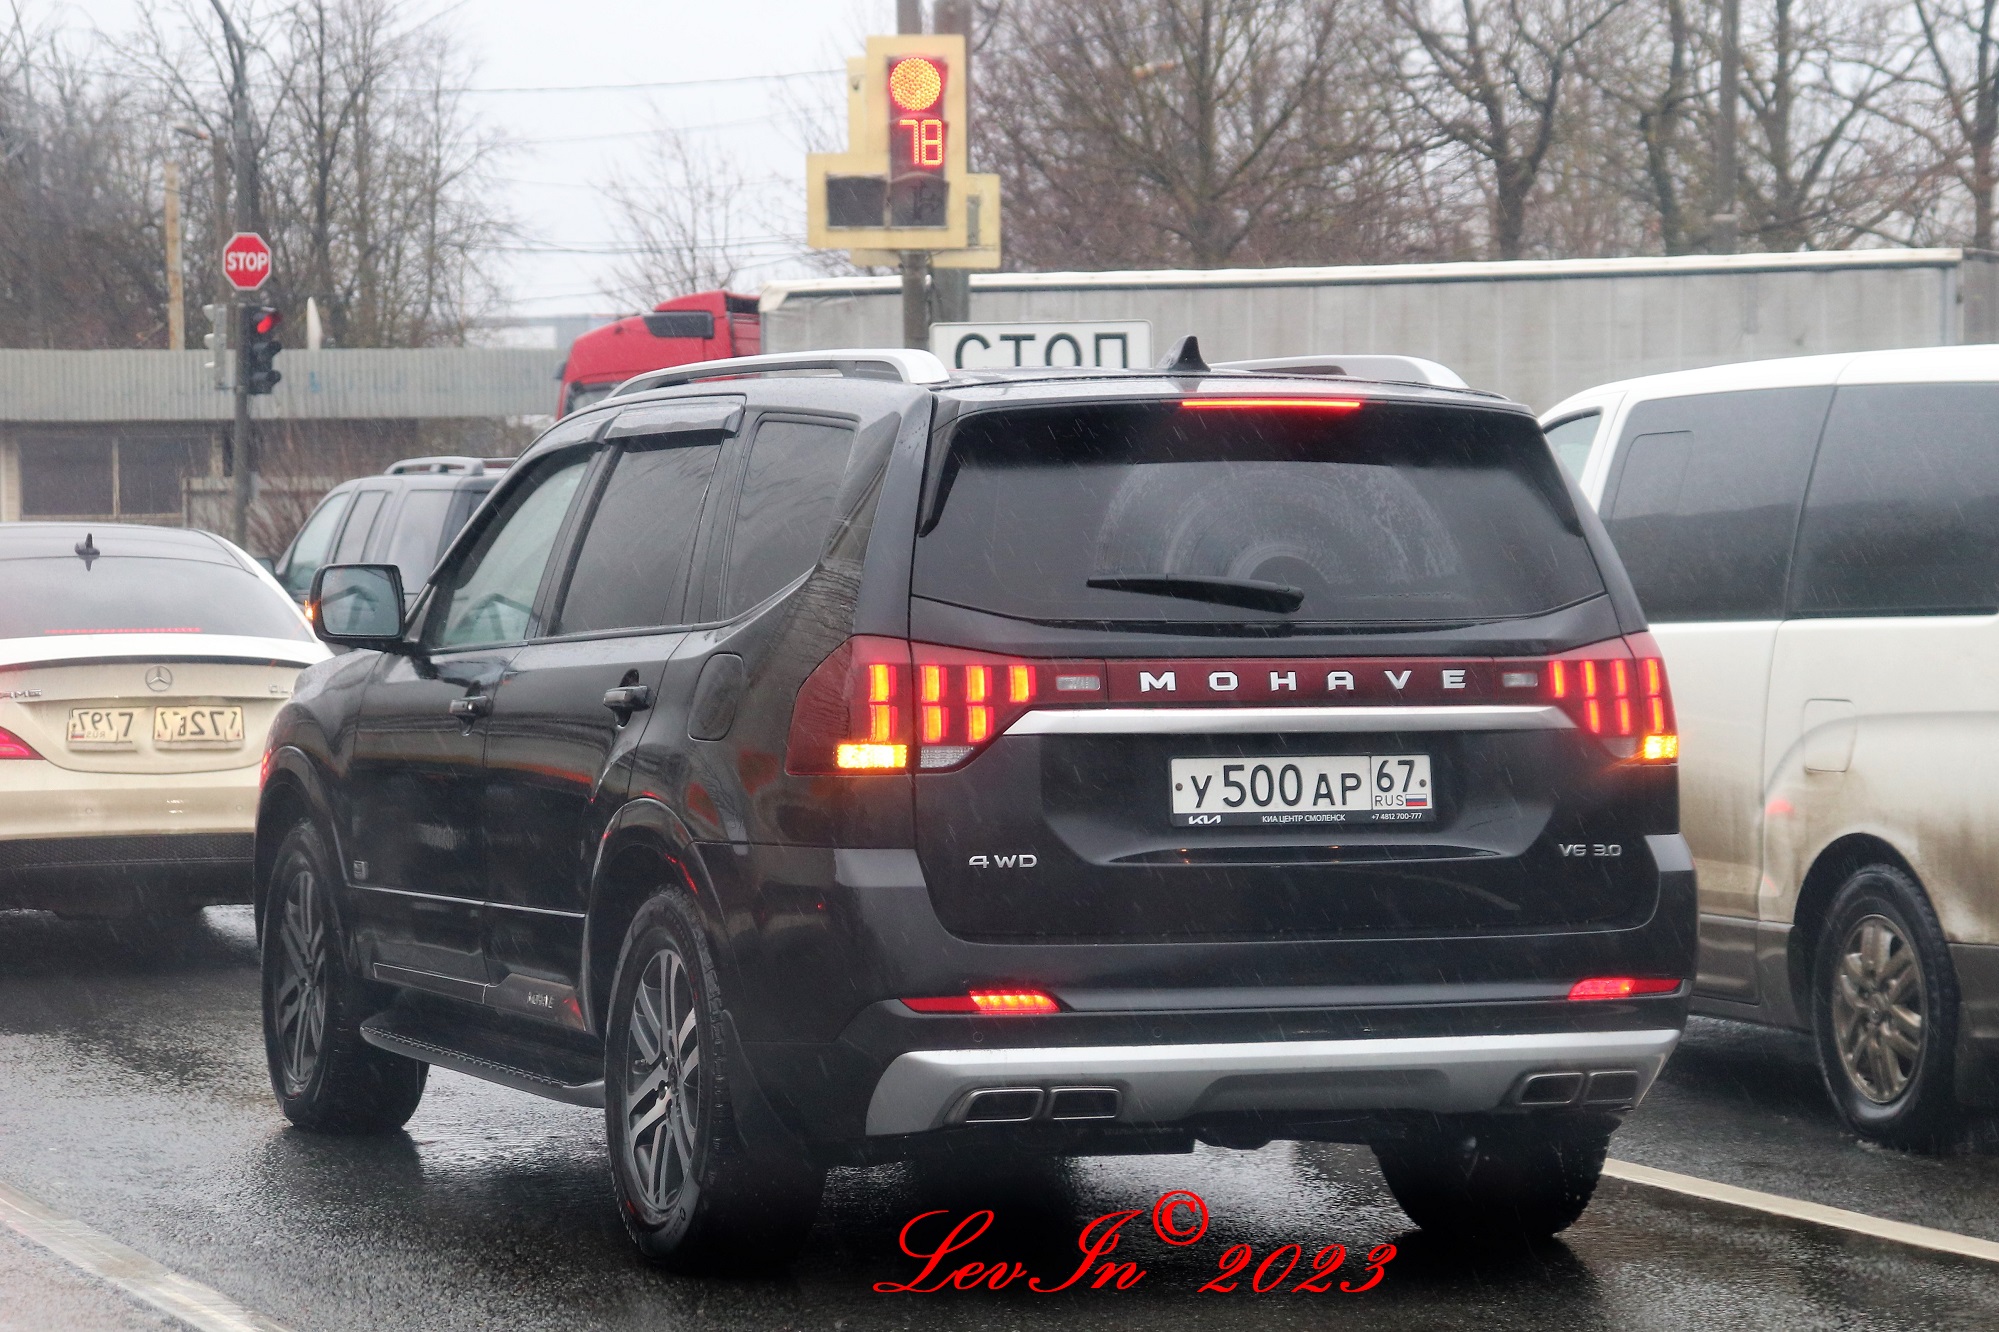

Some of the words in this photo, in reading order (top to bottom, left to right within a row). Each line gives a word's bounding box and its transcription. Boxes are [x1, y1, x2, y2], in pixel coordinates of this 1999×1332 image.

[900, 119, 942, 166] 78
[227, 251, 268, 271] STOP
[955, 332, 1128, 368] СТОП
[1139, 669, 1466, 692] MOHAVE
[1376, 759, 1415, 793] 67
[1374, 794, 1404, 807] RUS
[1262, 815, 1278, 823] КИА
[1279, 814, 1303, 823] ЦЕНТР
[1304, 813, 1346, 822] СМОЛЕНСК
[1396, 812, 1422, 820] 700-777
[1558, 843, 1587, 857] V6
[1593, 843, 1622, 857] 3.0
[968, 854, 1038, 869] 4WD
